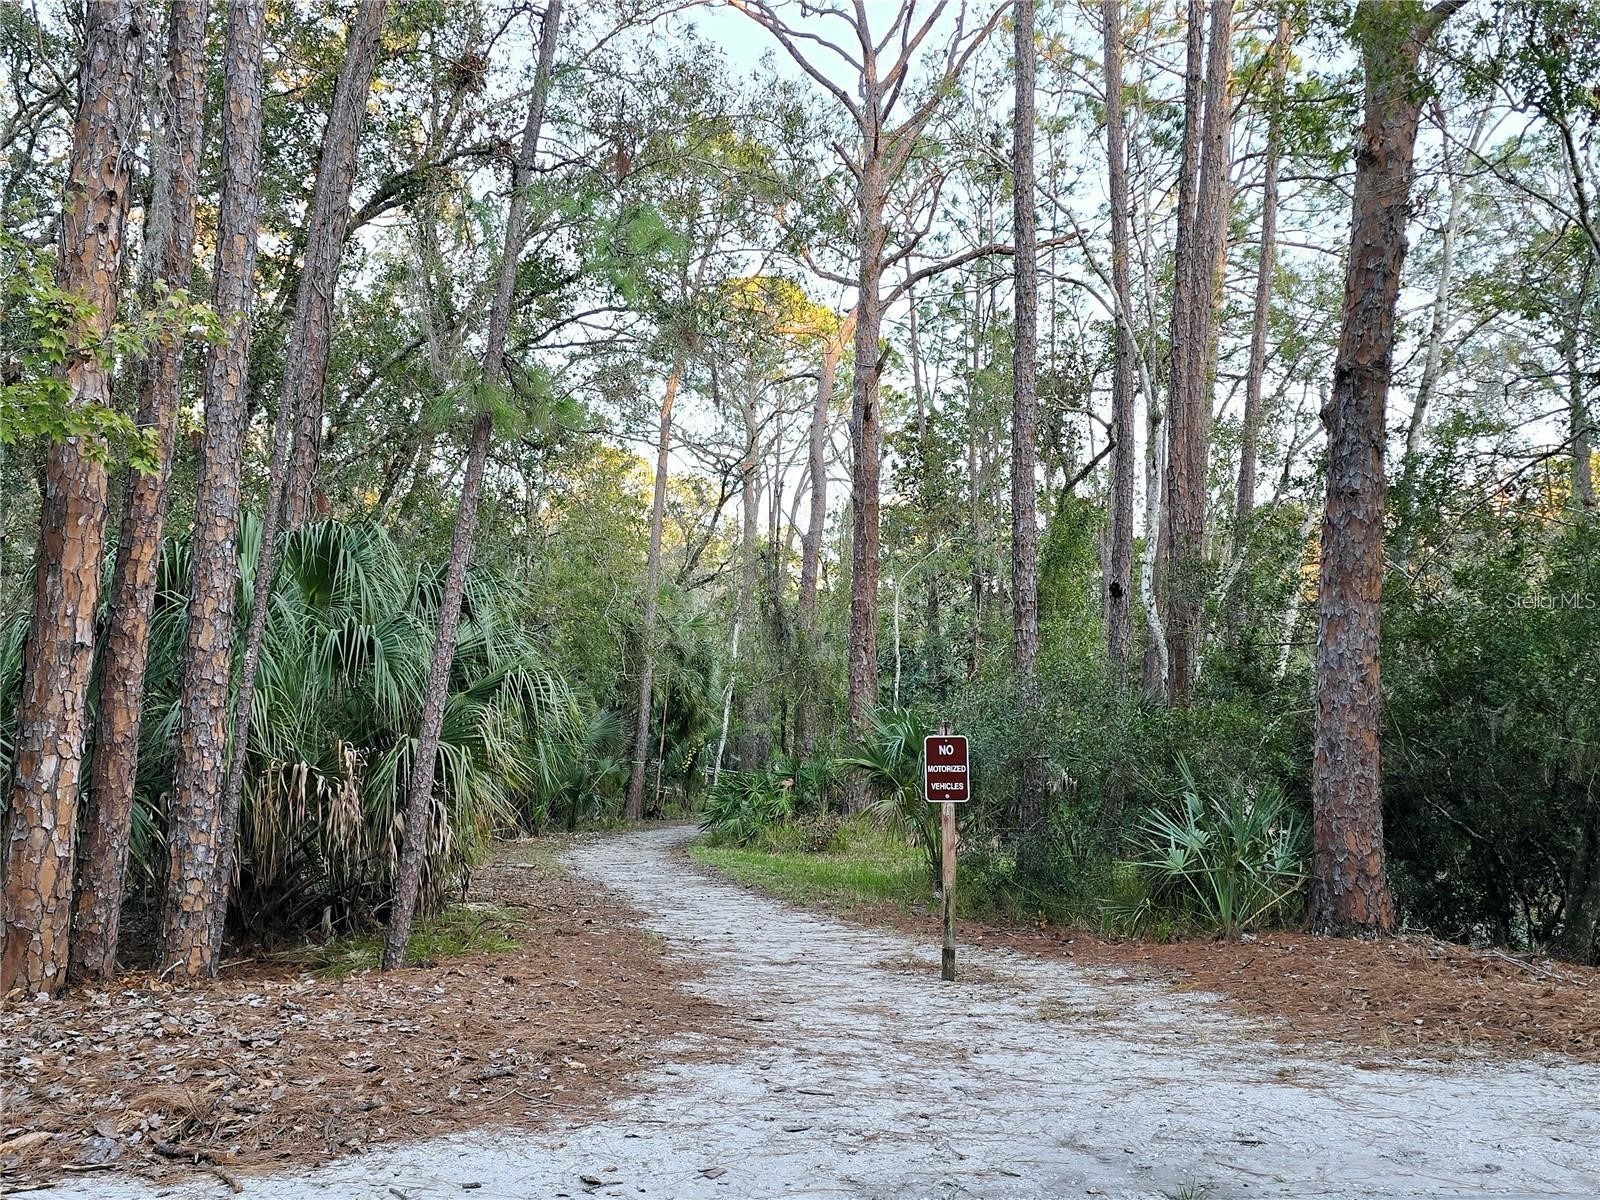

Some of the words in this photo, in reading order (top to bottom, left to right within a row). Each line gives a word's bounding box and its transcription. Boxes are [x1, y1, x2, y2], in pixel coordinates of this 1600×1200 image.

[938, 745, 954, 755] NO
[927, 765, 966, 773] MOTORIZED
[931, 782, 964, 790] VEHICLES
